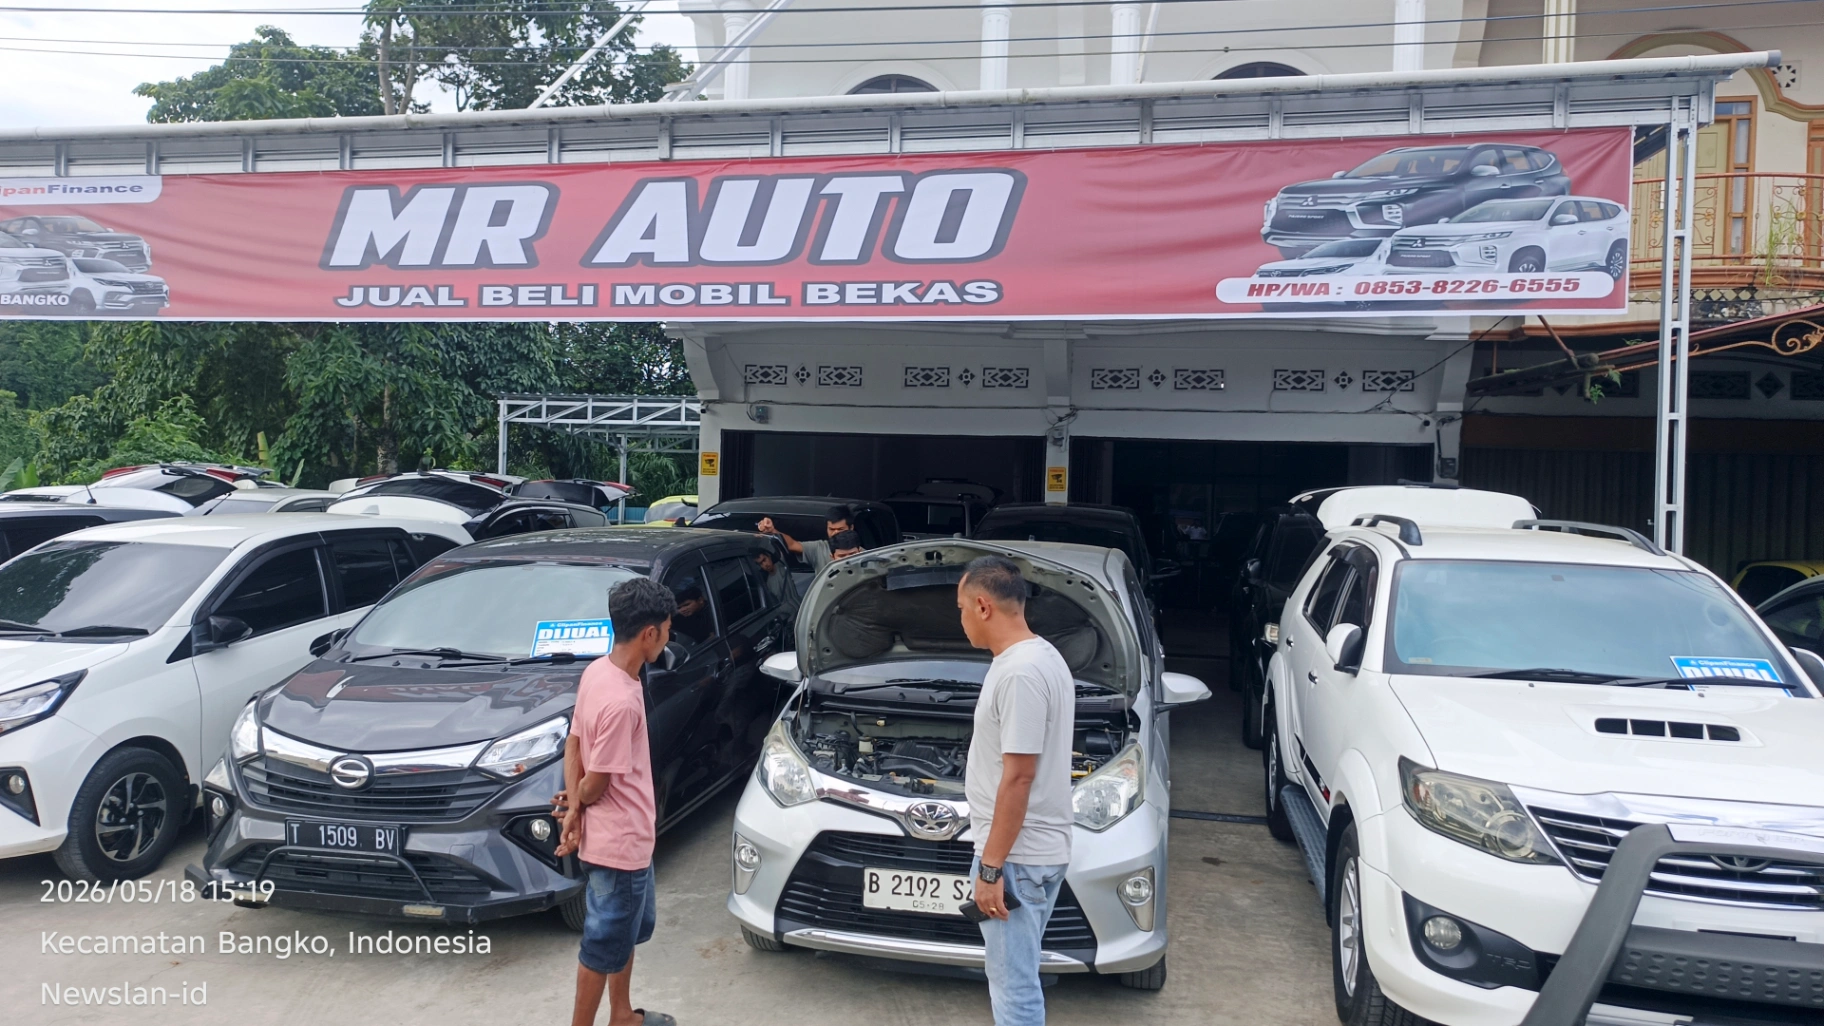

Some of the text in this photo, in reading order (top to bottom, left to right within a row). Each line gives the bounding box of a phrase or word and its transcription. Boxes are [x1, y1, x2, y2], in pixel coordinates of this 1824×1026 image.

[0, 185, 143, 197] panFinance
[329, 172, 1016, 266] MR AUTO
[337, 281, 998, 306] JUAL BELI MOBIL BEKAS
[1247, 283, 1330, 297] HP/WA
[1354, 278, 1580, 296] 0853-8226-6555
[0, 294, 69, 306] BANGKO
[538, 626, 610, 639] DIJUAL
[290, 824, 394, 850] T 1509 BV
[868, 872, 880, 893] B
[891, 874, 940, 898] 2192
